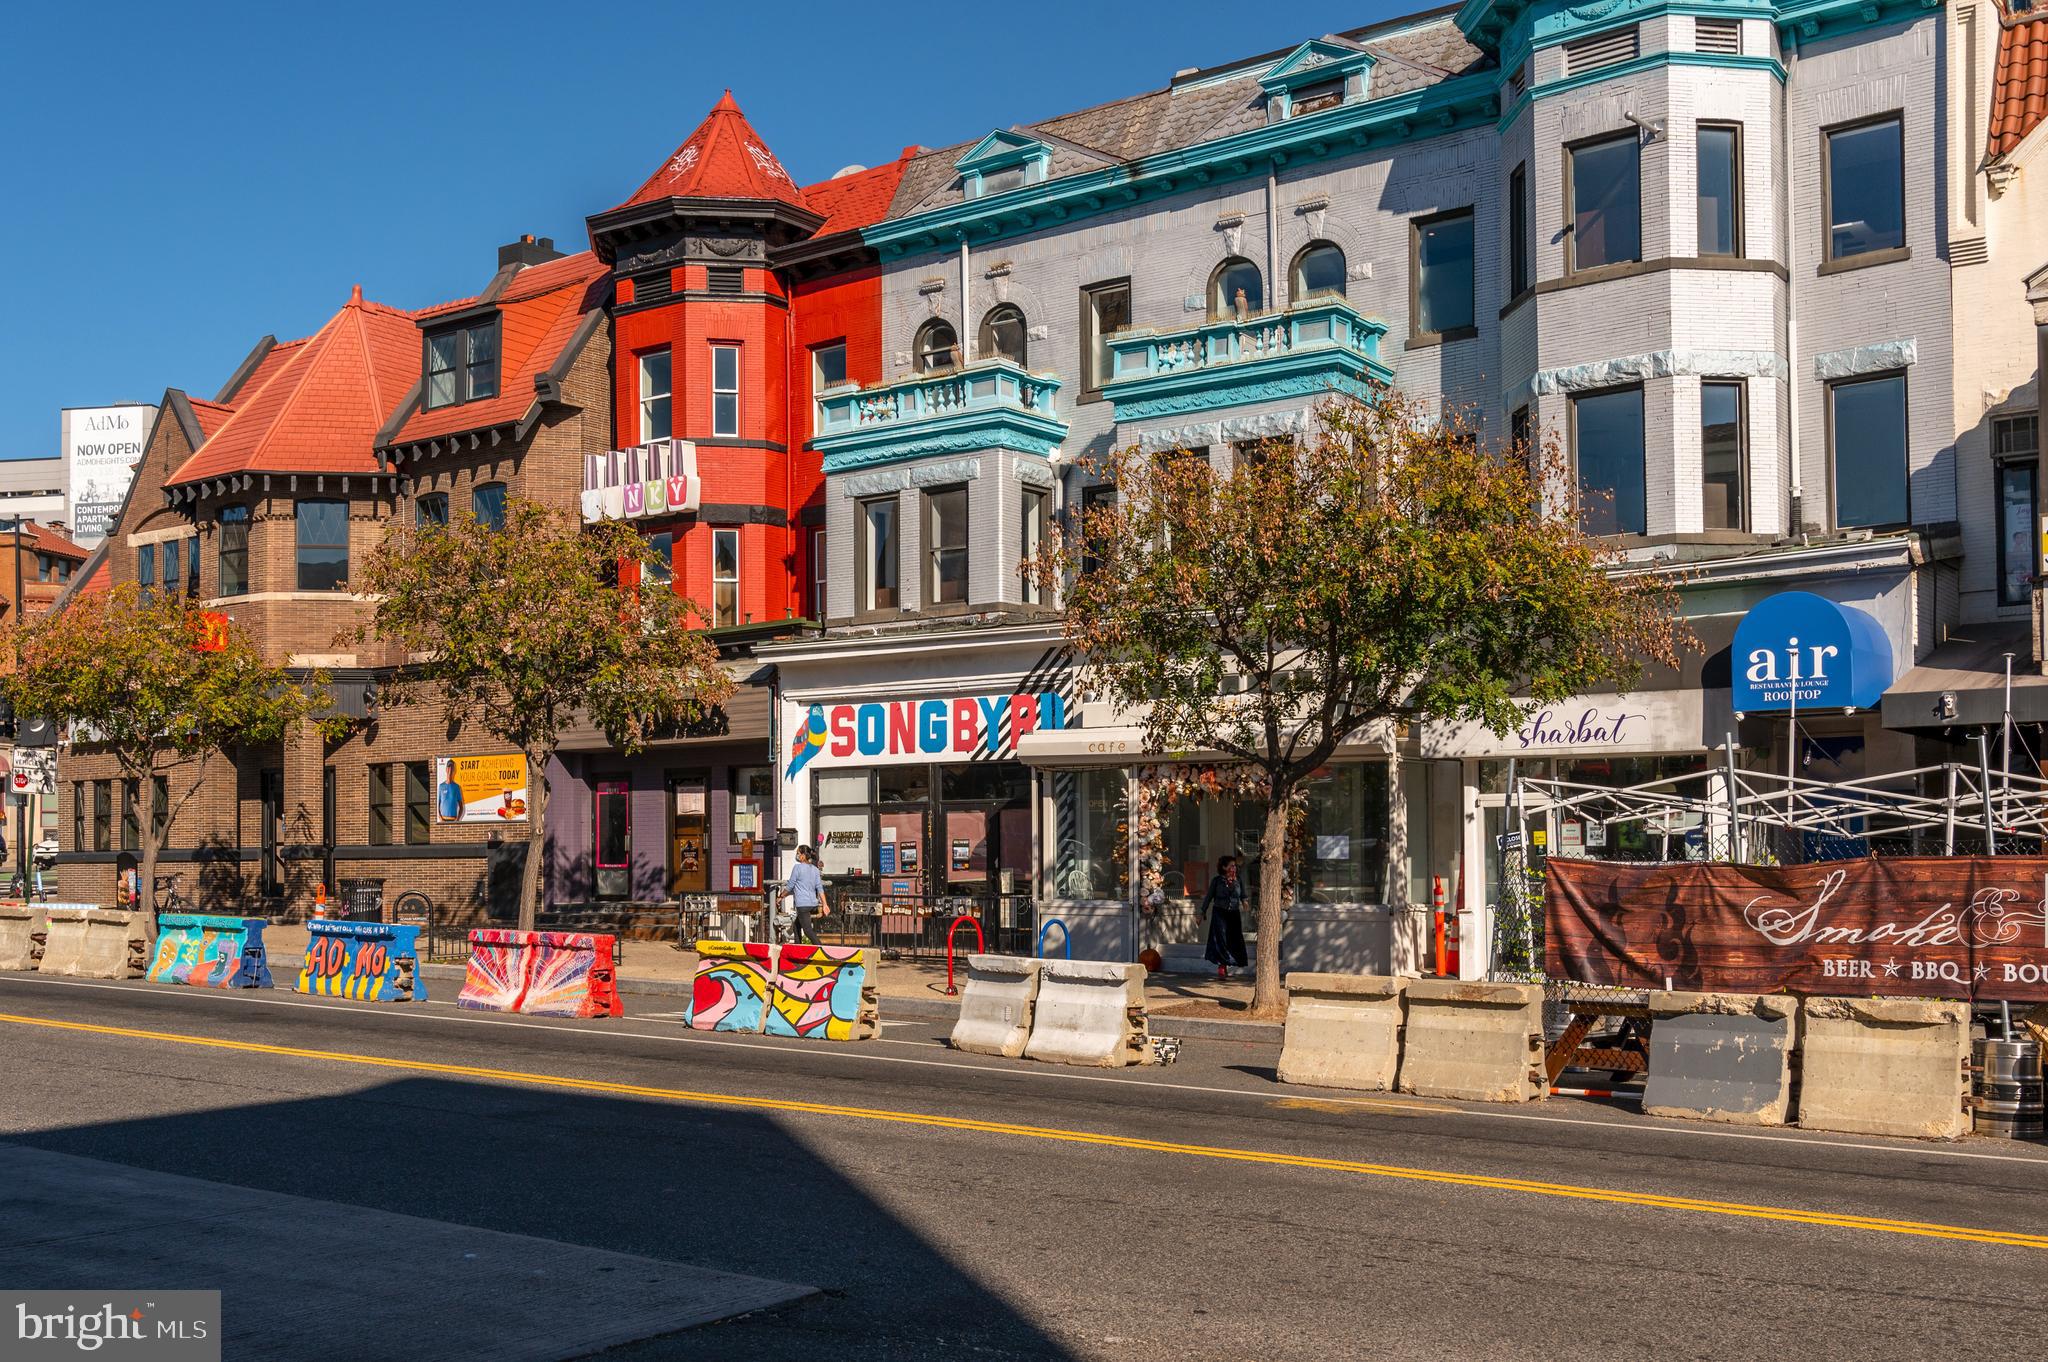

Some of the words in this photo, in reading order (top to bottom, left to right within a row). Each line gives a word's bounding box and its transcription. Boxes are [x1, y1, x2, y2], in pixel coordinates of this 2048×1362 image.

[85, 415, 129, 431] AdMo
[77, 444, 105, 456] NOW
[108, 442, 140, 455] OPEN
[77, 524, 102, 533] LIVING
[1746, 637, 1838, 682] air
[1801, 680, 1829, 688] LOUNGE
[1519, 708, 1646, 748] sharbat
[1089, 741, 1126, 752] cafe
[460, 760, 480, 770] START
[481, 758, 514, 769] ACHIEVING
[460, 771, 476, 782] YOUR
[477, 770, 497, 782] GOALS
[498, 769, 520, 781] TODAY
[1744, 869, 1958, 947] Smoke
[354, 941, 387, 980] MO
[1823, 959, 1876, 978] BEER
[1911, 961, 1971, 985] BBQ
